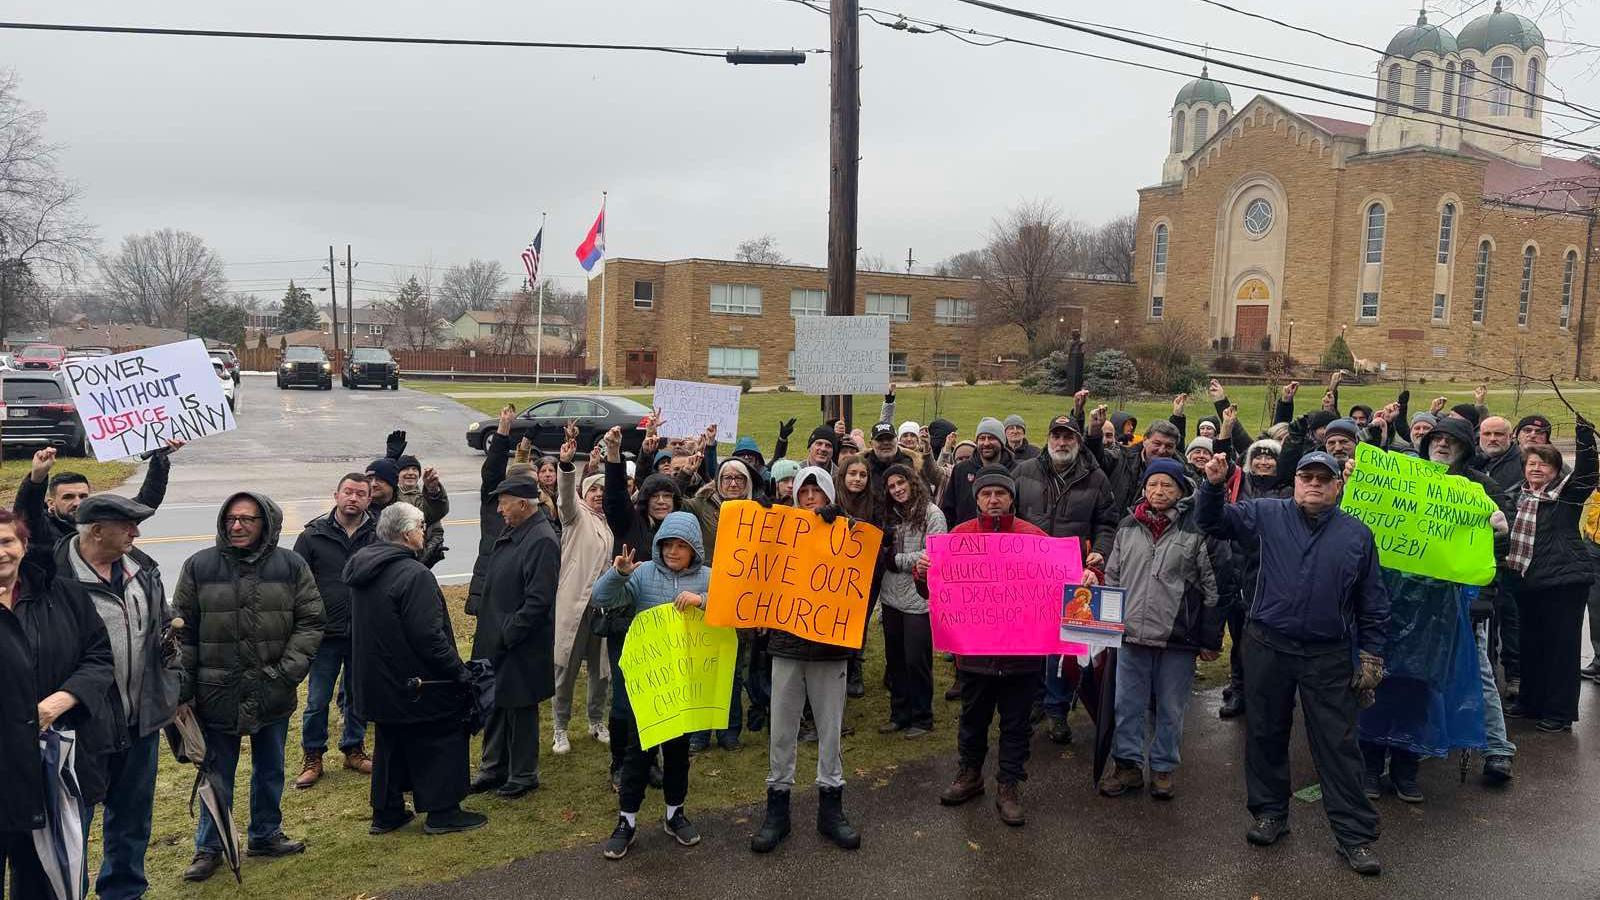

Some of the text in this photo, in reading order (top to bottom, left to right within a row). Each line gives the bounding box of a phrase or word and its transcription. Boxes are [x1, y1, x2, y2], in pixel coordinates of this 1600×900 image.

[66, 356, 158, 395] POWER
[89, 373, 181, 415] WITHOUT
[89, 394, 199, 440] JUSTICE IS
[110, 403, 226, 455] TYRANNY
[1360, 450, 1400, 474] CRKVA
[1354, 469, 1417, 495] DONACIJE
[1426, 483, 1443, 500] NA
[1392, 496, 1418, 514] NAM
[736, 509, 864, 558] HELP US
[999, 536, 1024, 554] GO
[728, 549, 864, 599] SAVE OUR
[941, 561, 1072, 581] CHURCH BECAUSE
[940, 587, 952, 604] OF
[961, 585, 1024, 604] DRAGAN
[736, 591, 850, 641] CHURCH
[645, 662, 675, 690] KIDS
[703, 656, 720, 672] OF
